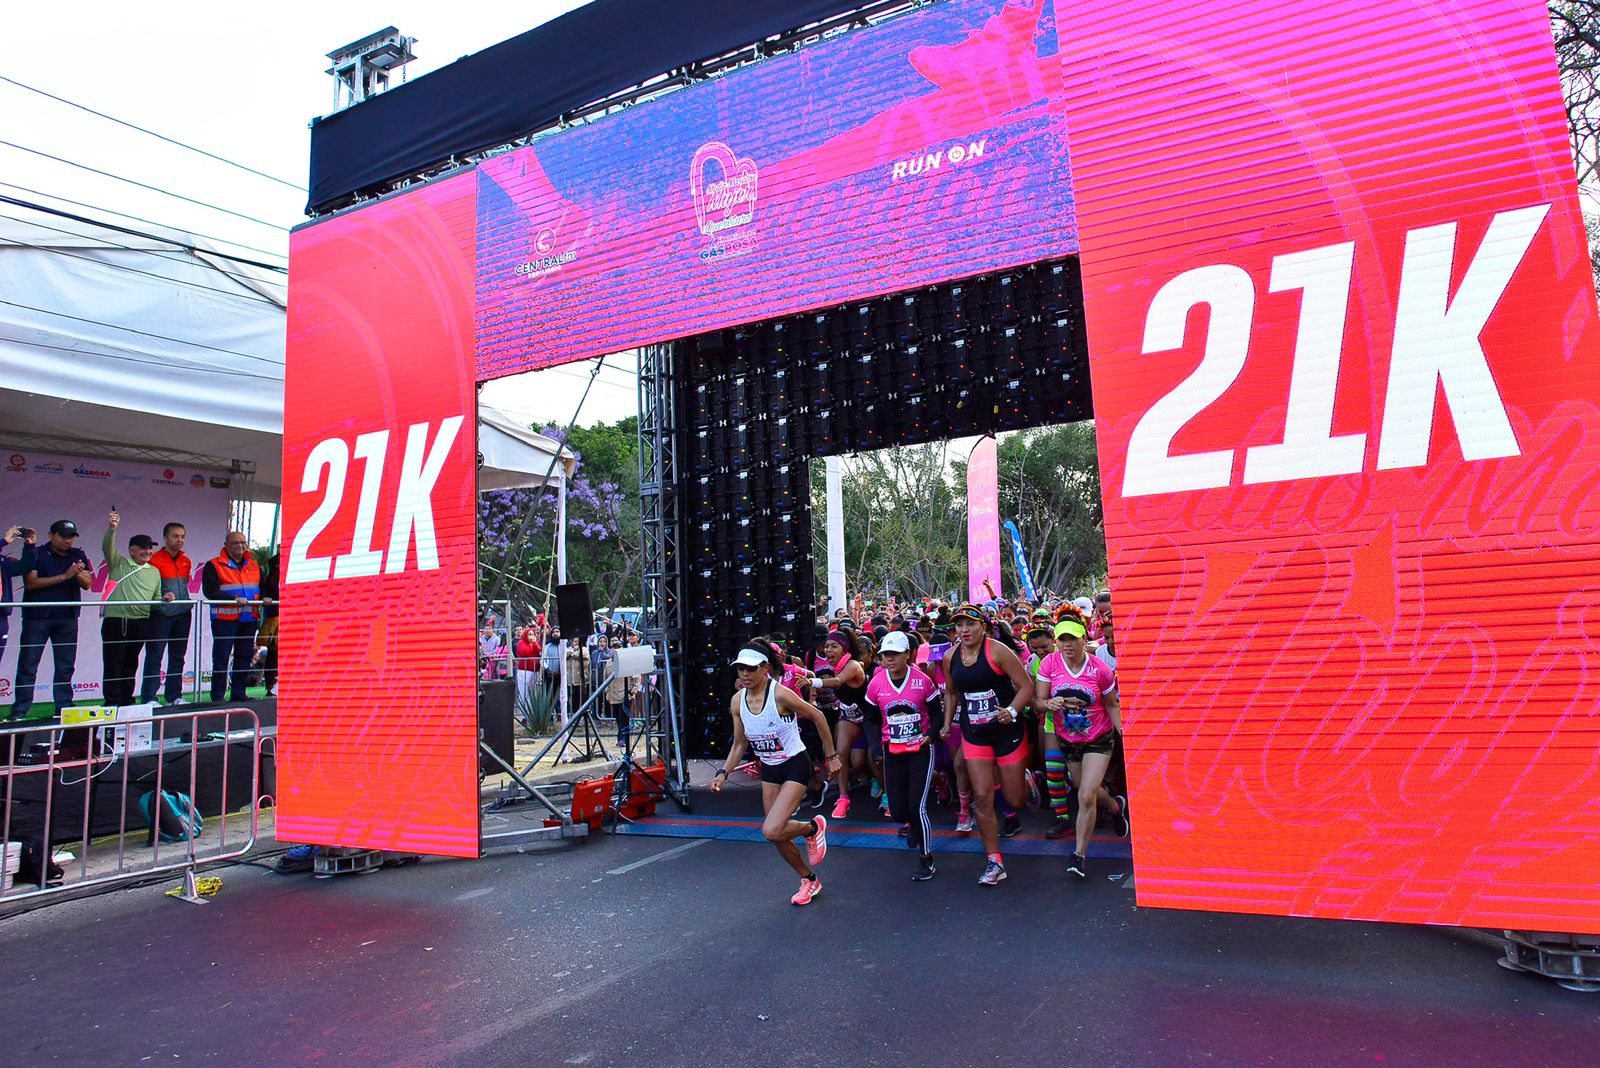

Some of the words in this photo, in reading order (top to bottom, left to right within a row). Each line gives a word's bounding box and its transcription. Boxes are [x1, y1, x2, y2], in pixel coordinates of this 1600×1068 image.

[892, 151, 942, 180] RUN
[948, 137, 987, 163] ON
[1121, 203, 1552, 498] 21K
[285, 415, 465, 584] 21K
[72, 682, 100, 691] SROSA
[910, 678, 923, 687] 21K
[978, 699, 989, 711] 13
[898, 722, 915, 736] 752
